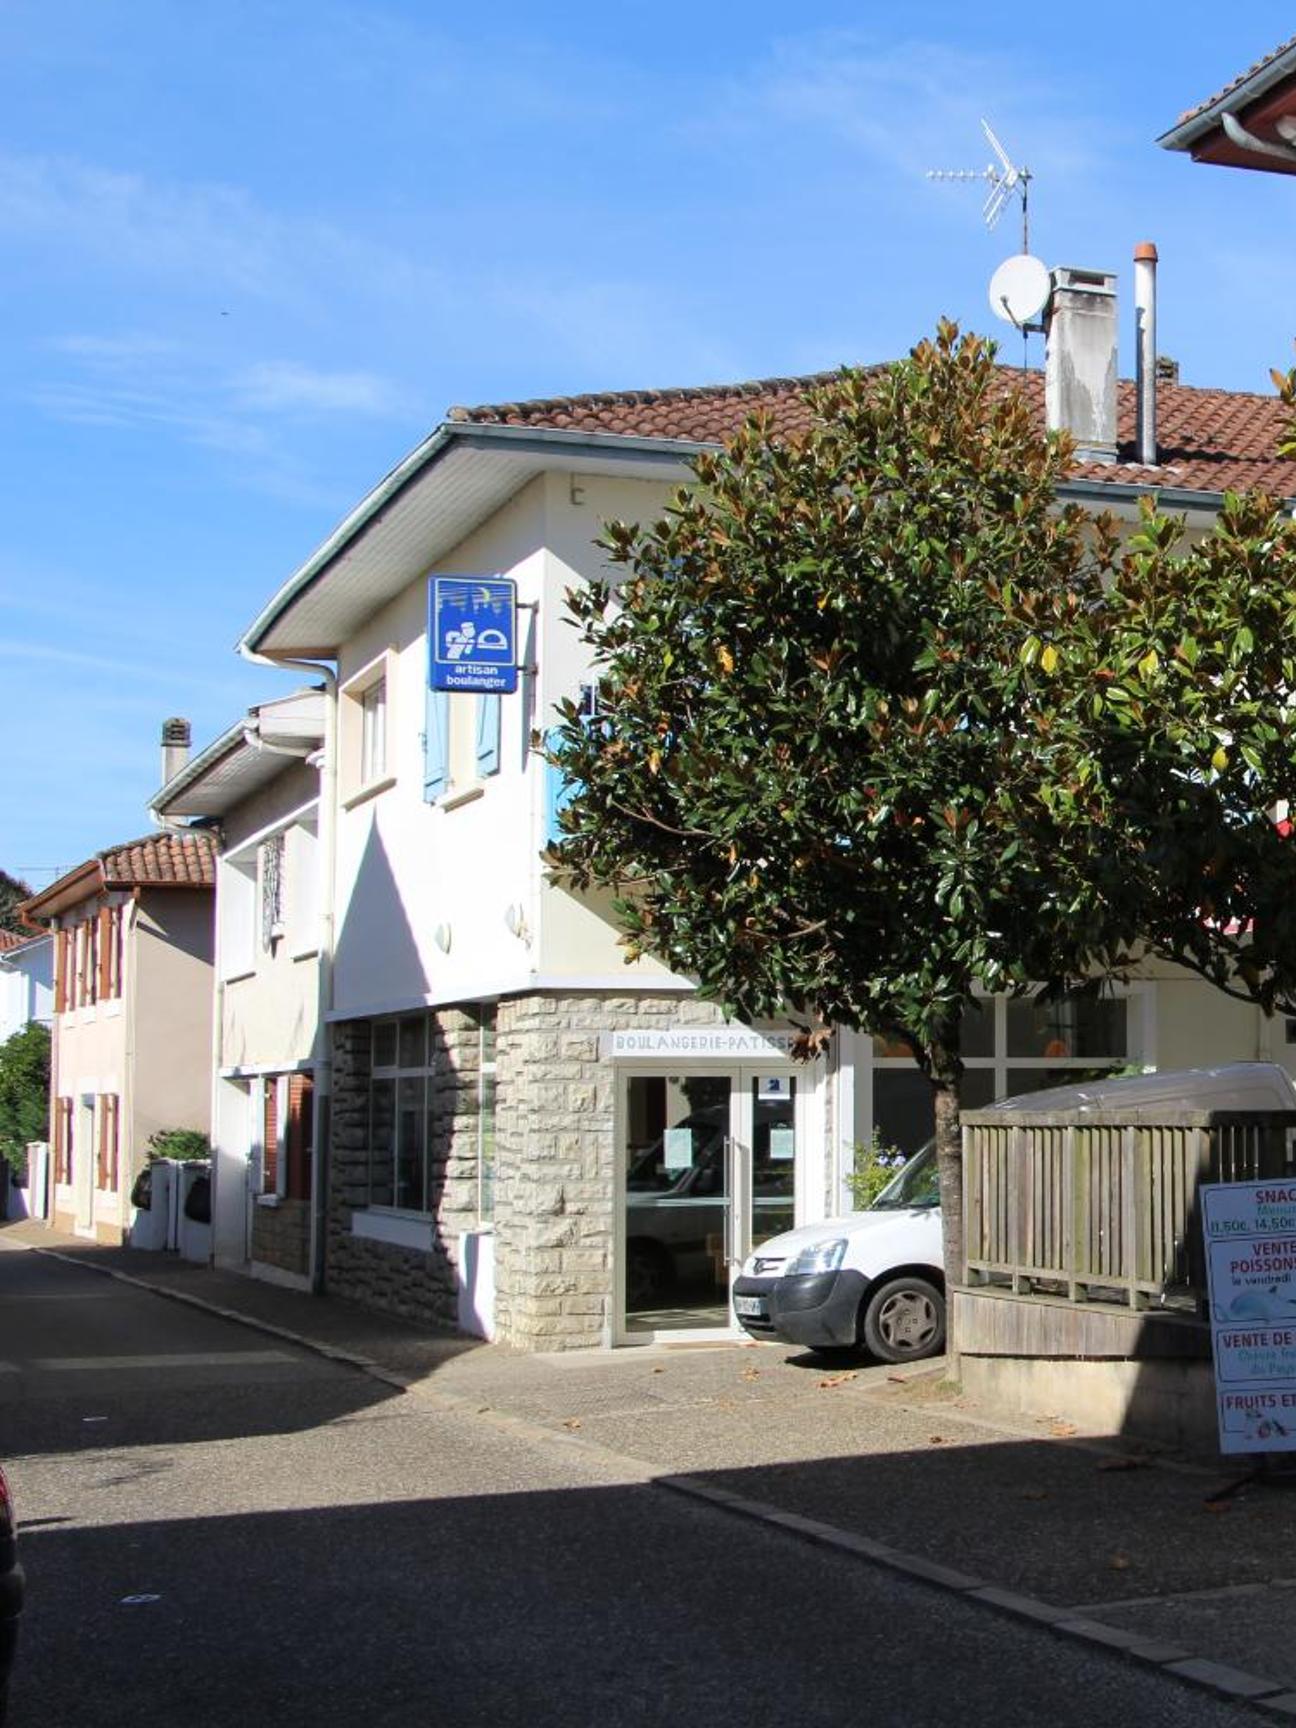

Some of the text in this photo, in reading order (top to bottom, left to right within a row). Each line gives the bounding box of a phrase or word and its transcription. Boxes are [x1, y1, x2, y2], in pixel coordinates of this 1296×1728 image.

[454, 664, 499, 676] artisan
[446, 675, 507, 689] boulanger
[1245, 1272, 1292, 1286] vendredi
[1223, 1333, 1269, 1349] VENTE
[1272, 1331, 1293, 1346] DE
[1225, 1394, 1277, 1409] FRUITS
